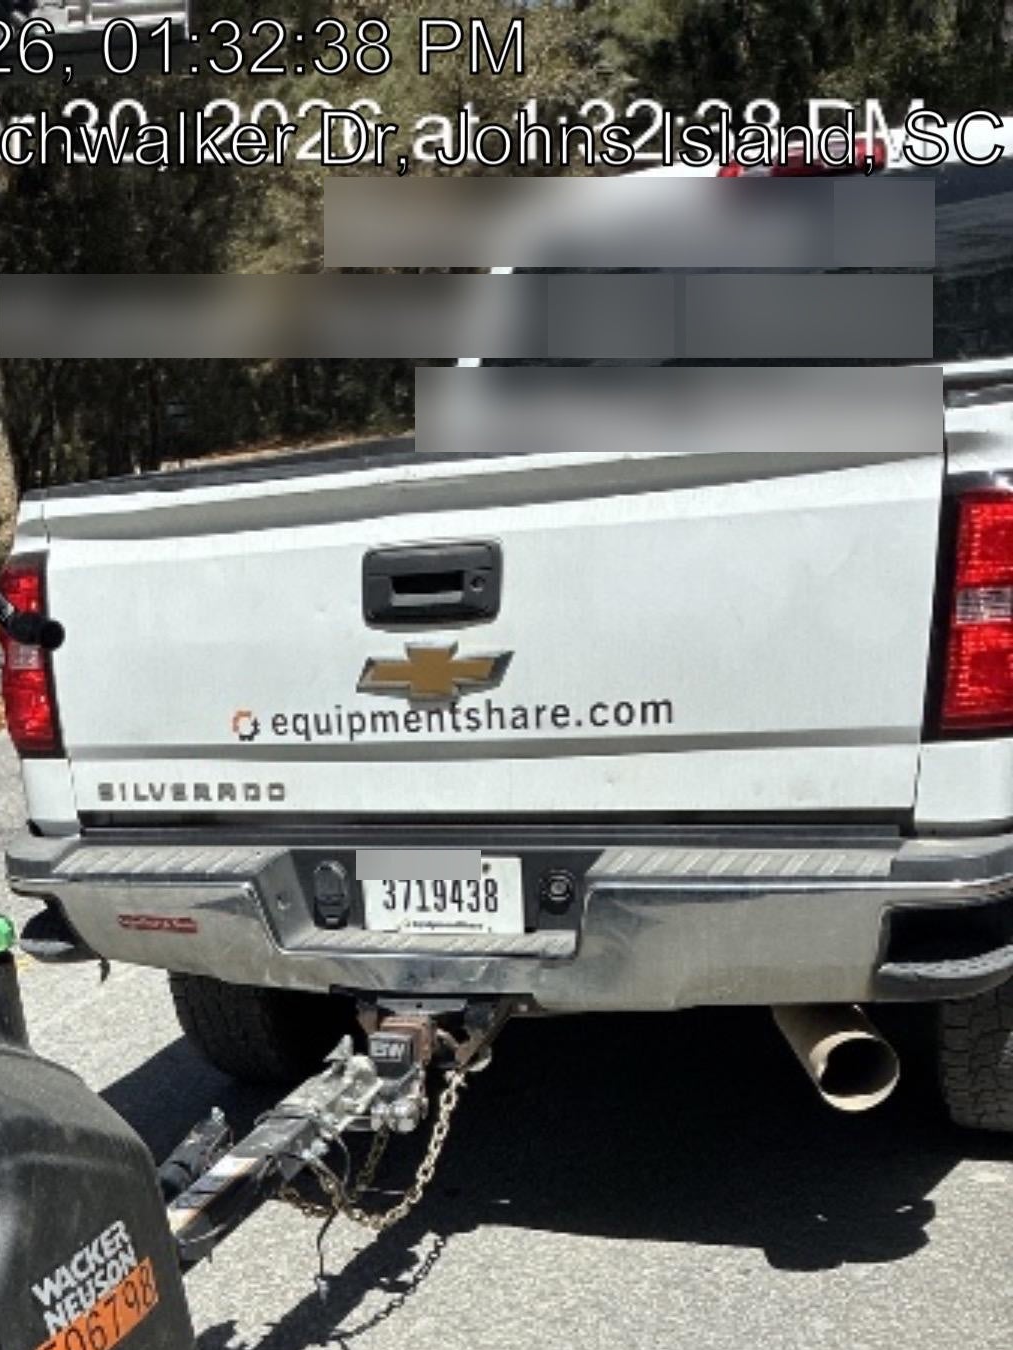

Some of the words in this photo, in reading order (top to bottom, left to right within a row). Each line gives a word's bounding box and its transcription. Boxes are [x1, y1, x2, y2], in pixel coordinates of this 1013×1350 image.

[271, 697, 675, 742] equipmentshare.com
[96, 782, 286, 802] SILVERADO
[382, 877, 499, 913] 3719438
[30, 1219, 132, 1307] WACKER
